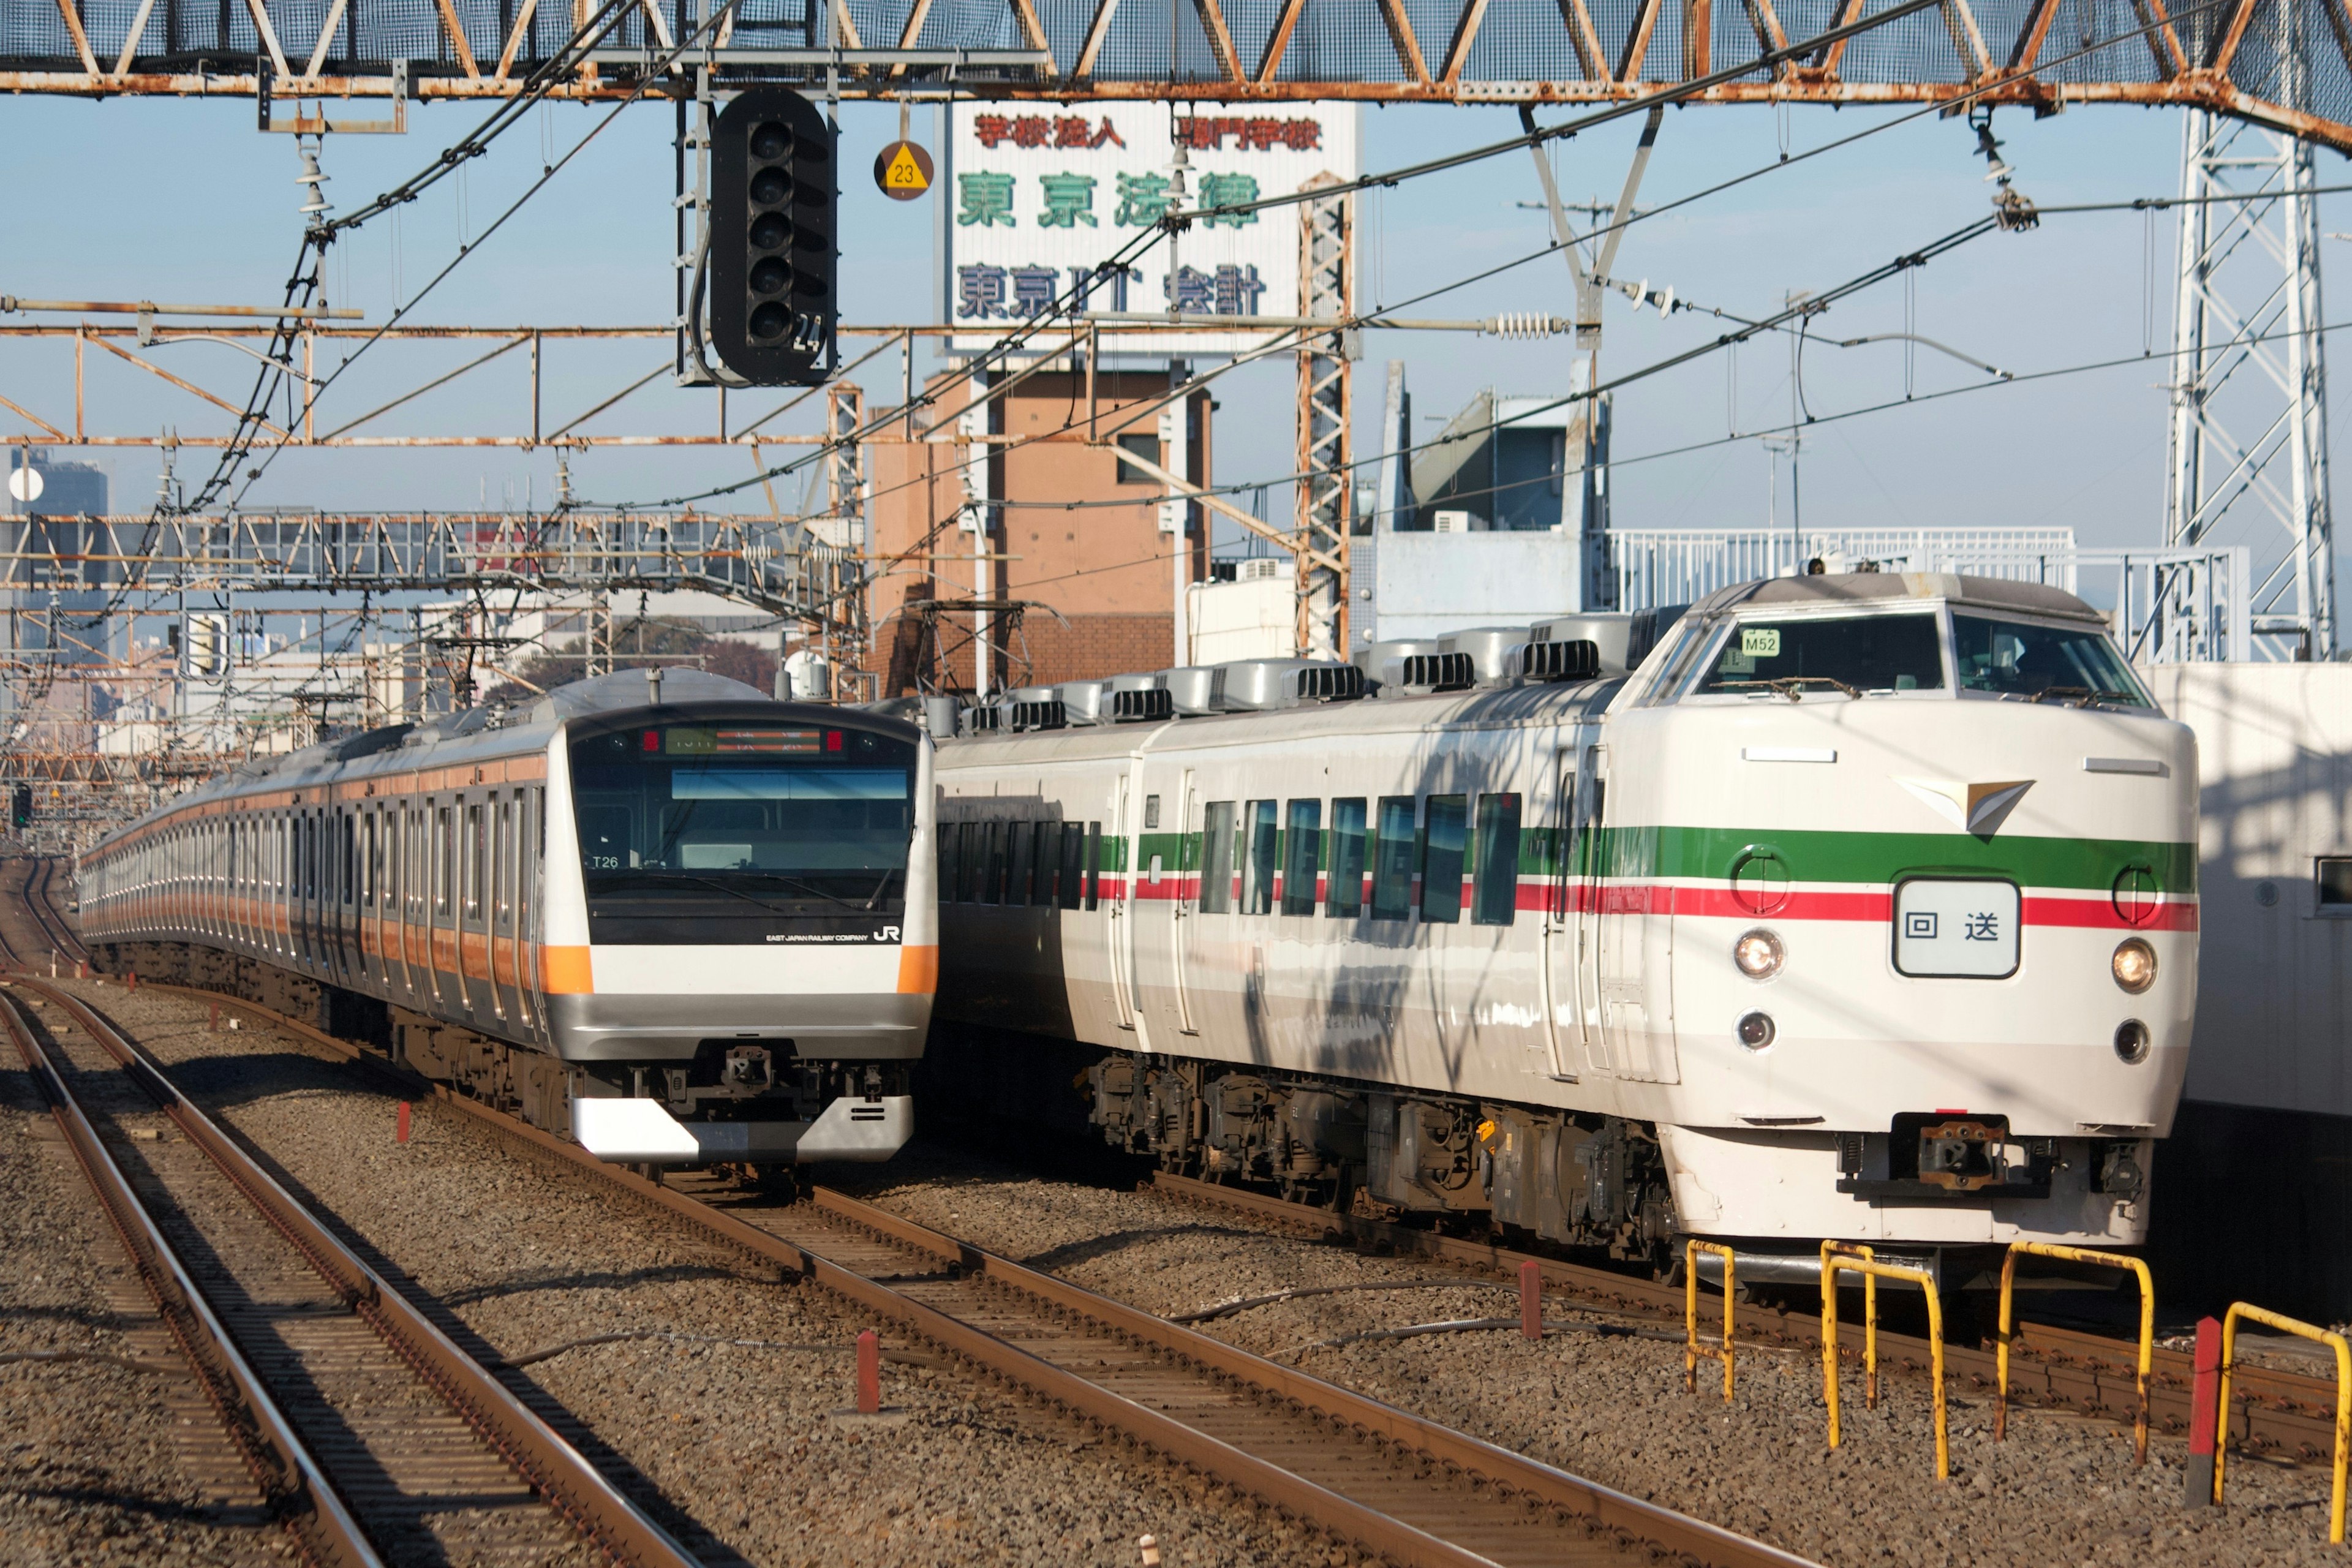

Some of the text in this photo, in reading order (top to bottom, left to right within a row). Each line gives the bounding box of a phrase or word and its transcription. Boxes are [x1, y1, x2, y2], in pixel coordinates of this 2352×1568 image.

[974, 114, 1125, 148] 学校法人
[895, 164, 913, 183] 23
[957, 170, 1259, 228] 東京法律
[793, 313, 821, 352] 24
[1746, 638, 1776, 650] M52
[592, 856, 619, 868] T26
[873, 925, 900, 941] JR
[1905, 911, 1999, 941] 回送
